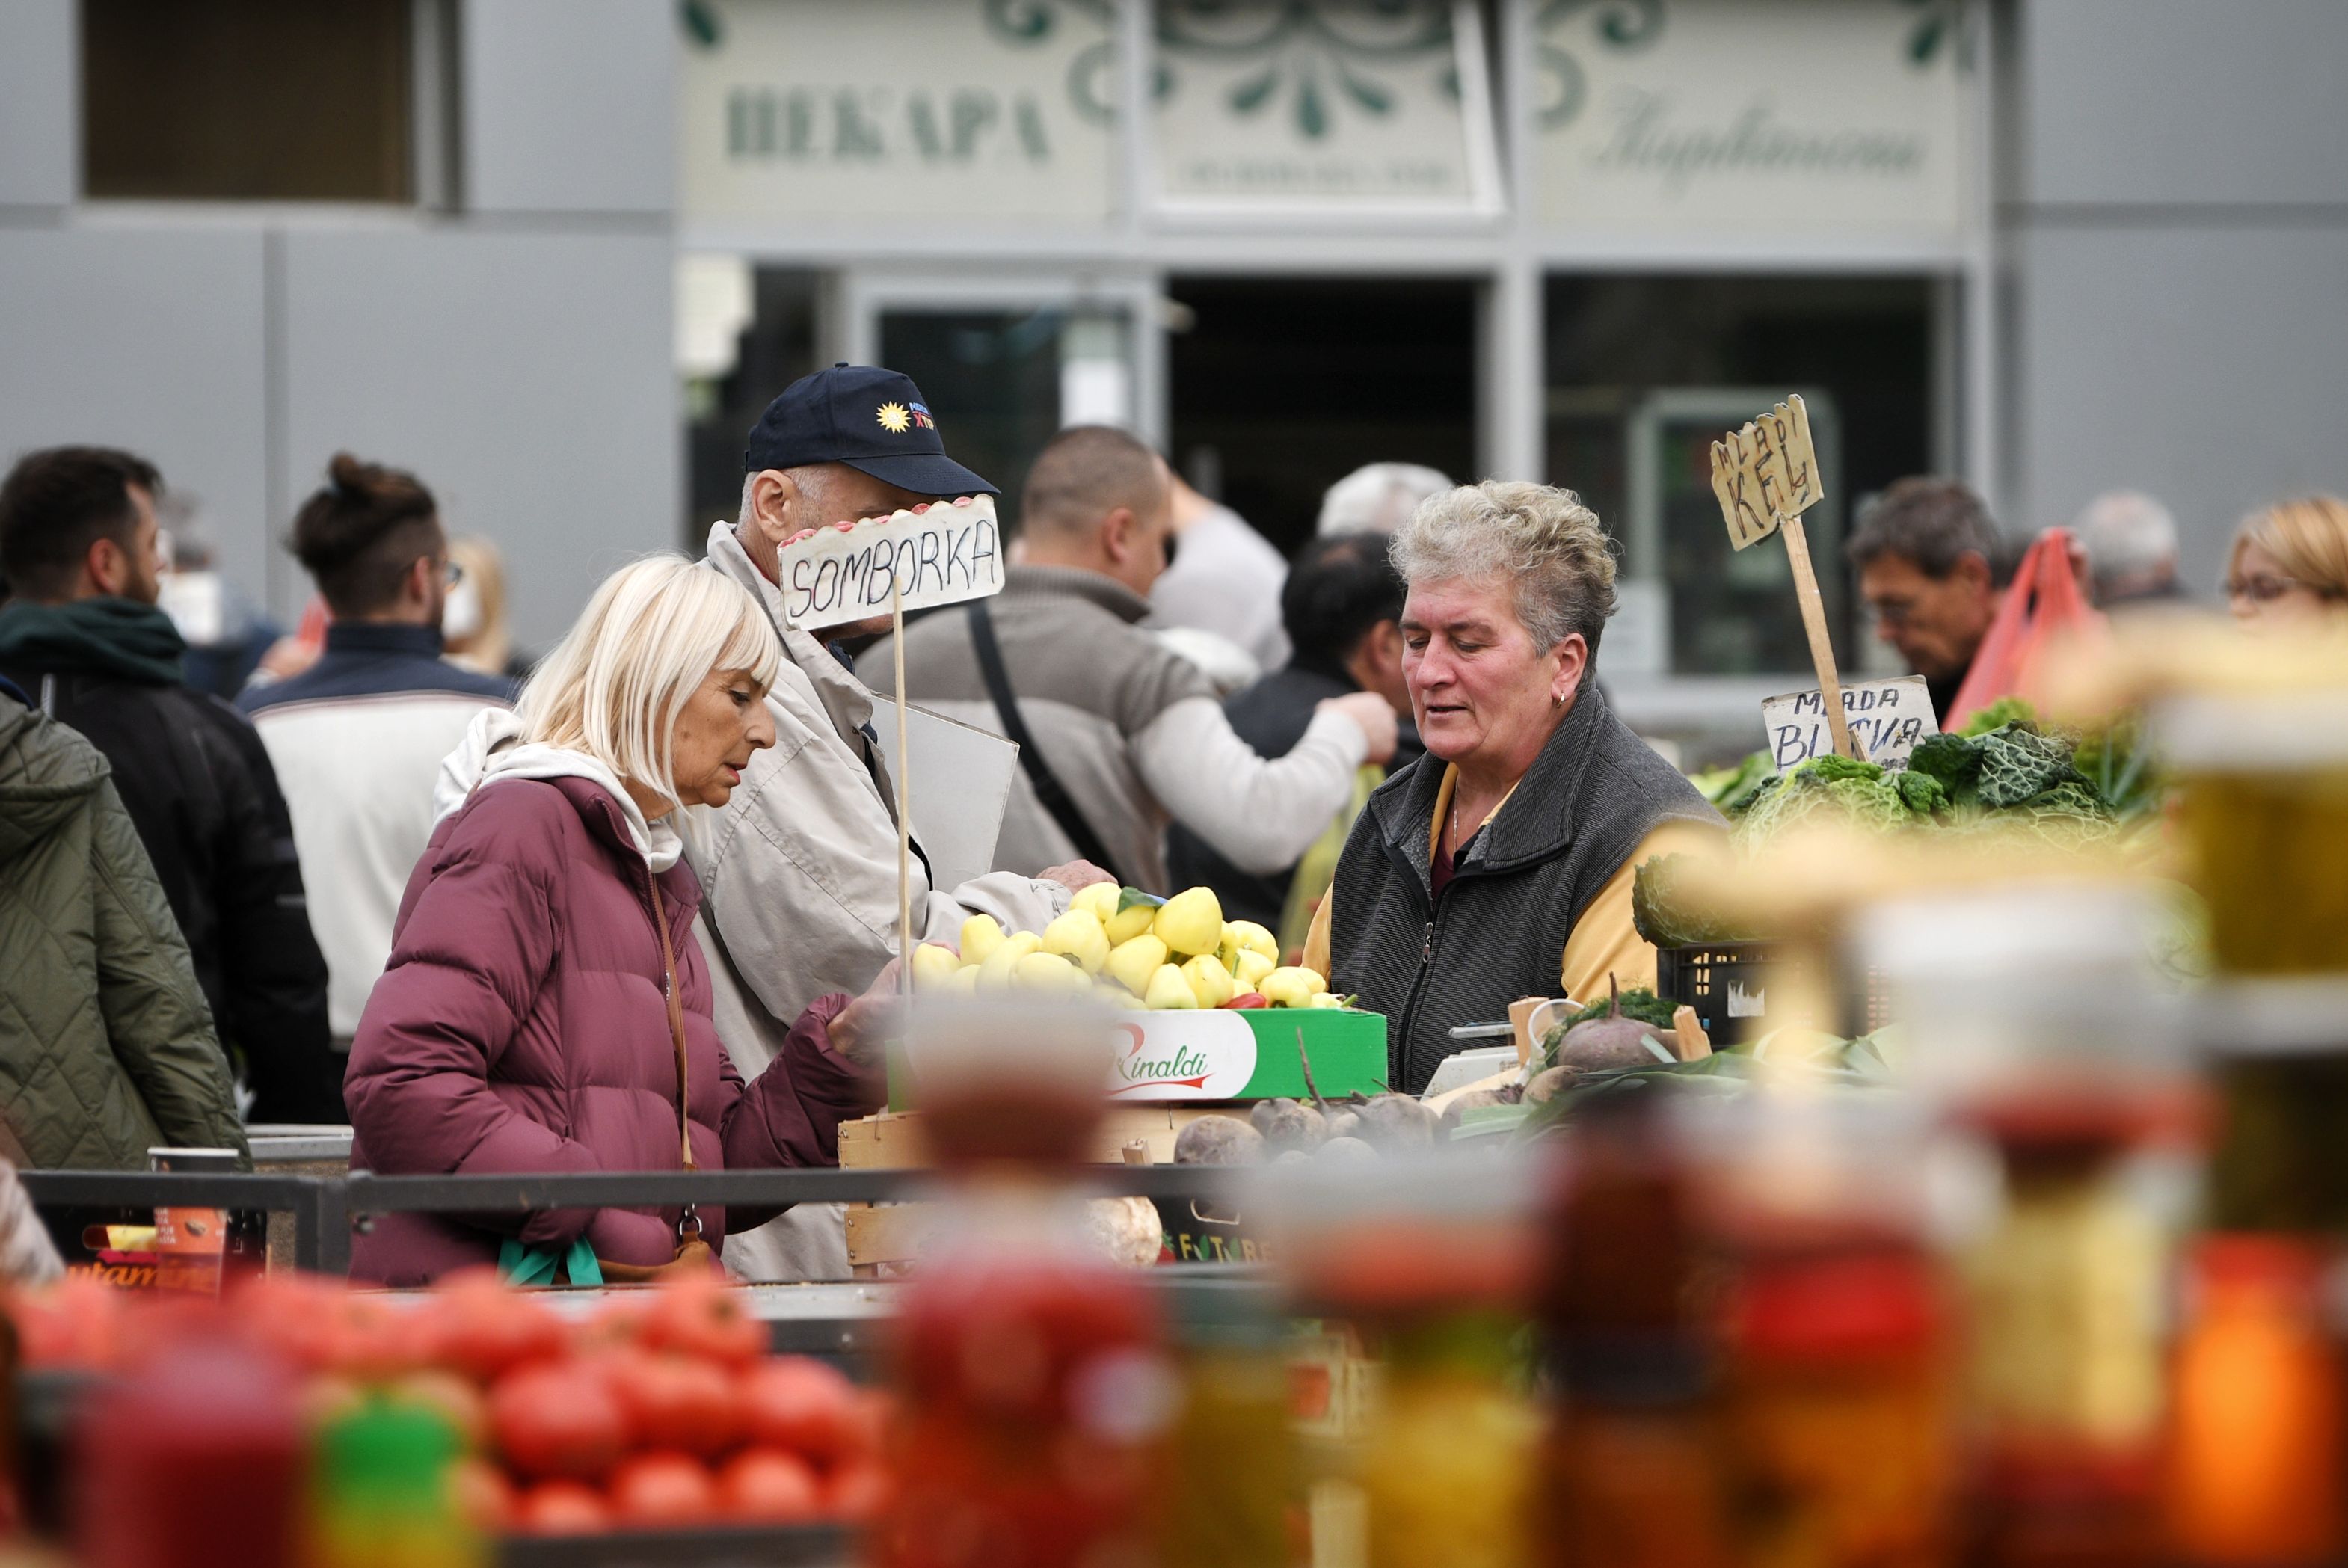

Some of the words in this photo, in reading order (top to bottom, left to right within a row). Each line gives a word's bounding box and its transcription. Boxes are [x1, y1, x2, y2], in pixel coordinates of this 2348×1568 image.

[1716, 408, 1798, 471] MLADI
[790, 520, 995, 618] SOMBORKA
[1795, 688, 1900, 717] MADA
